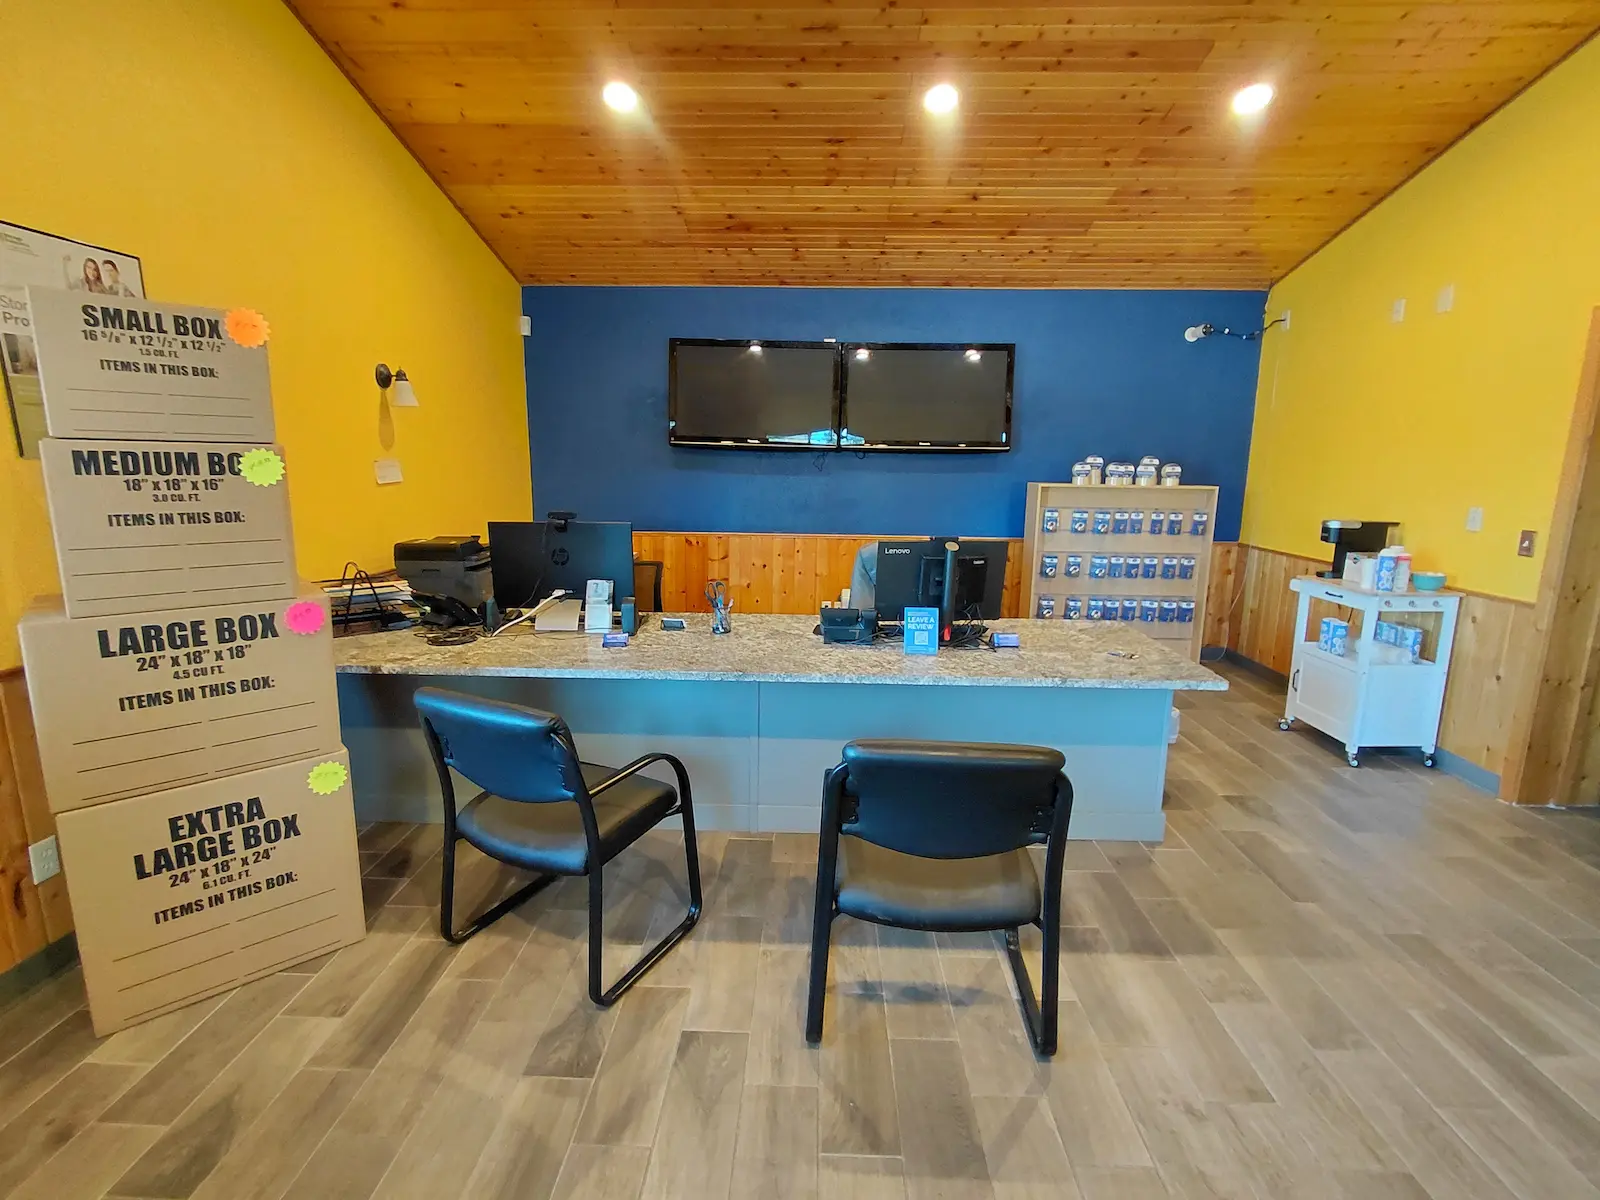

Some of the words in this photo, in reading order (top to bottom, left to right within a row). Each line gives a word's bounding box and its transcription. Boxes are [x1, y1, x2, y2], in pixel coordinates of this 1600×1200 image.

[81, 304, 168, 335] SMALL
[173, 315, 223, 340] BOX
[81, 329, 98, 342] 16
[139, 335, 153, 346] 12
[190, 340, 204, 351] 12
[139, 349, 152, 357] 1.5
[100, 359, 140, 374] ITEMS
[144, 362, 158, 375] IN
[159, 363, 189, 377] THIS
[192, 366, 219, 379] BOX:
[71, 449, 200, 476] MEDIUM
[207, 452, 243, 476] BO
[152, 494, 169, 502] 3.0
[107, 513, 156, 527] ITEMS
[159, 513, 174, 525] IN
[179, 511, 211, 525] THIS
[214, 510, 246, 524] BOX:
[884, 547, 911, 555] Lenovo
[97, 619, 209, 659] LARGE
[215, 612, 280, 645] BOX
[172, 669, 191, 680] 4.5
[118, 690, 174, 712] ITEMS
[177, 687, 195, 703] IN
[199, 681, 237, 700] THIS
[240, 675, 276, 693] BOX:
[168, 796, 266, 843] EXTRA
[133, 831, 236, 881] LARGE
[241, 813, 302, 851] BOX
[202, 880, 218, 890] 6.1
[219, 873, 237, 886] CU.
[154, 898, 205, 925] ITEMS
[208, 893, 225, 909] IN
[227, 882, 262, 902] THIS
[266, 871, 299, 890] BOX:
